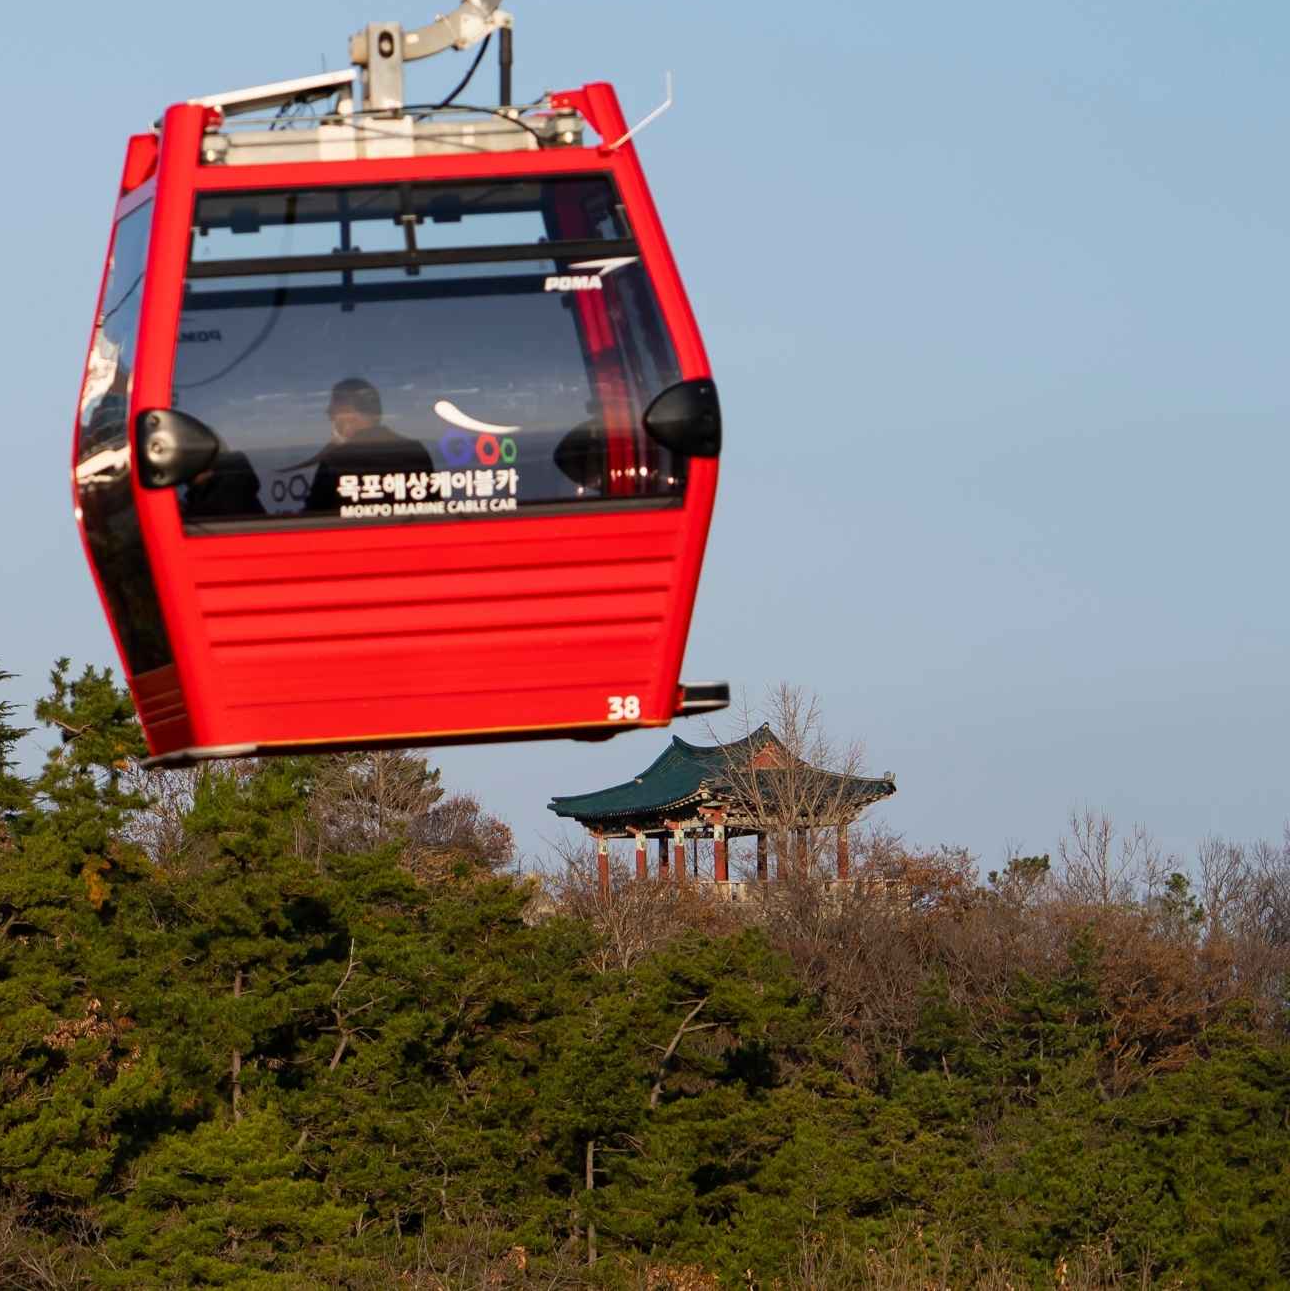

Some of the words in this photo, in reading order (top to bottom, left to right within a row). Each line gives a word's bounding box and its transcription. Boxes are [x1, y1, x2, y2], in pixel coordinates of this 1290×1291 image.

[545, 275, 602, 291] POMA
[337, 468, 519, 502] 목포해상케이블카
[340, 503, 392, 518] MOKPO
[393, 501, 445, 516] MARINE
[447, 500, 487, 514] CABLE
[489, 498, 517, 511] CAR
[607, 695, 640, 721] 38
